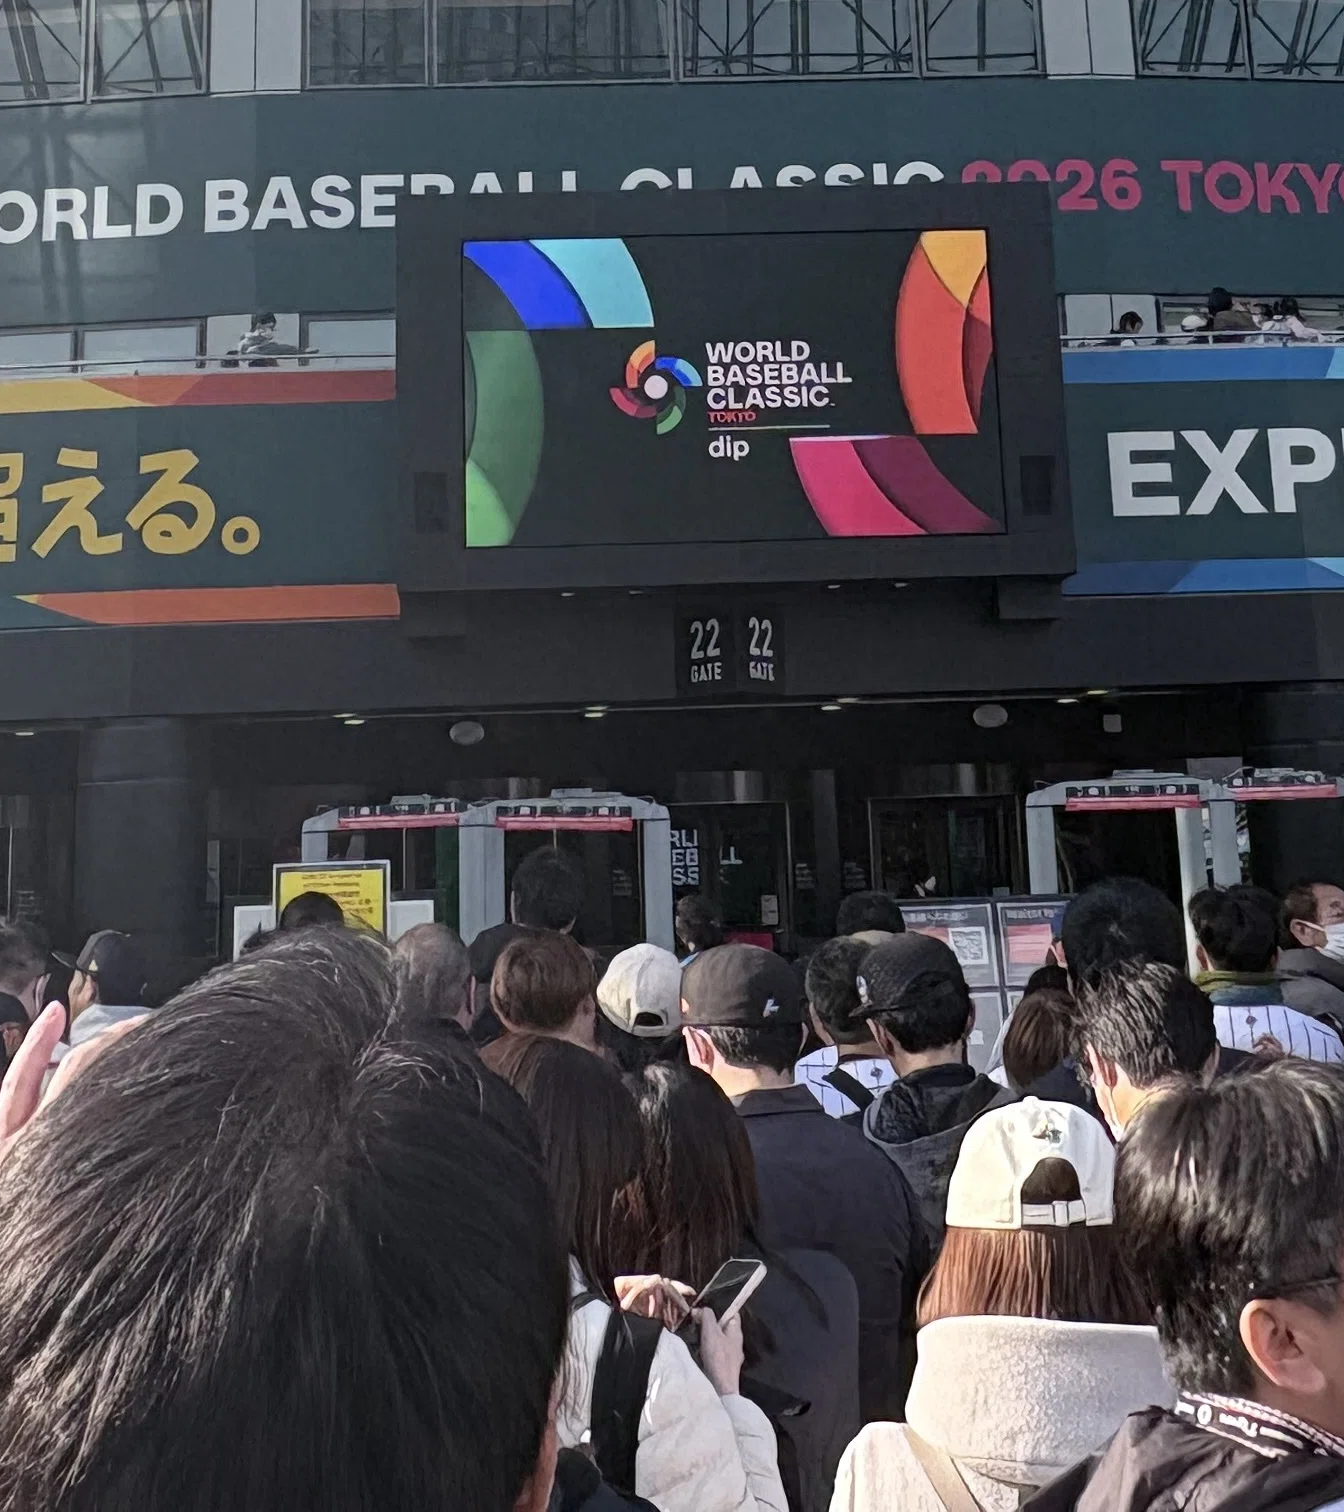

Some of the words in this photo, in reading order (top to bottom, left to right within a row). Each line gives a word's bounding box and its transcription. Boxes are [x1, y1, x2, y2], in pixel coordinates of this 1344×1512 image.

[705, 340, 811, 364] WORLD
[706, 361, 853, 387] BASEBALL
[706, 385, 831, 410] CLASSIC
[708, 435, 750, 461] dip
[690, 618, 721, 660] 22
[748, 616, 774, 657] 22
[690, 662, 723, 683] GATE
